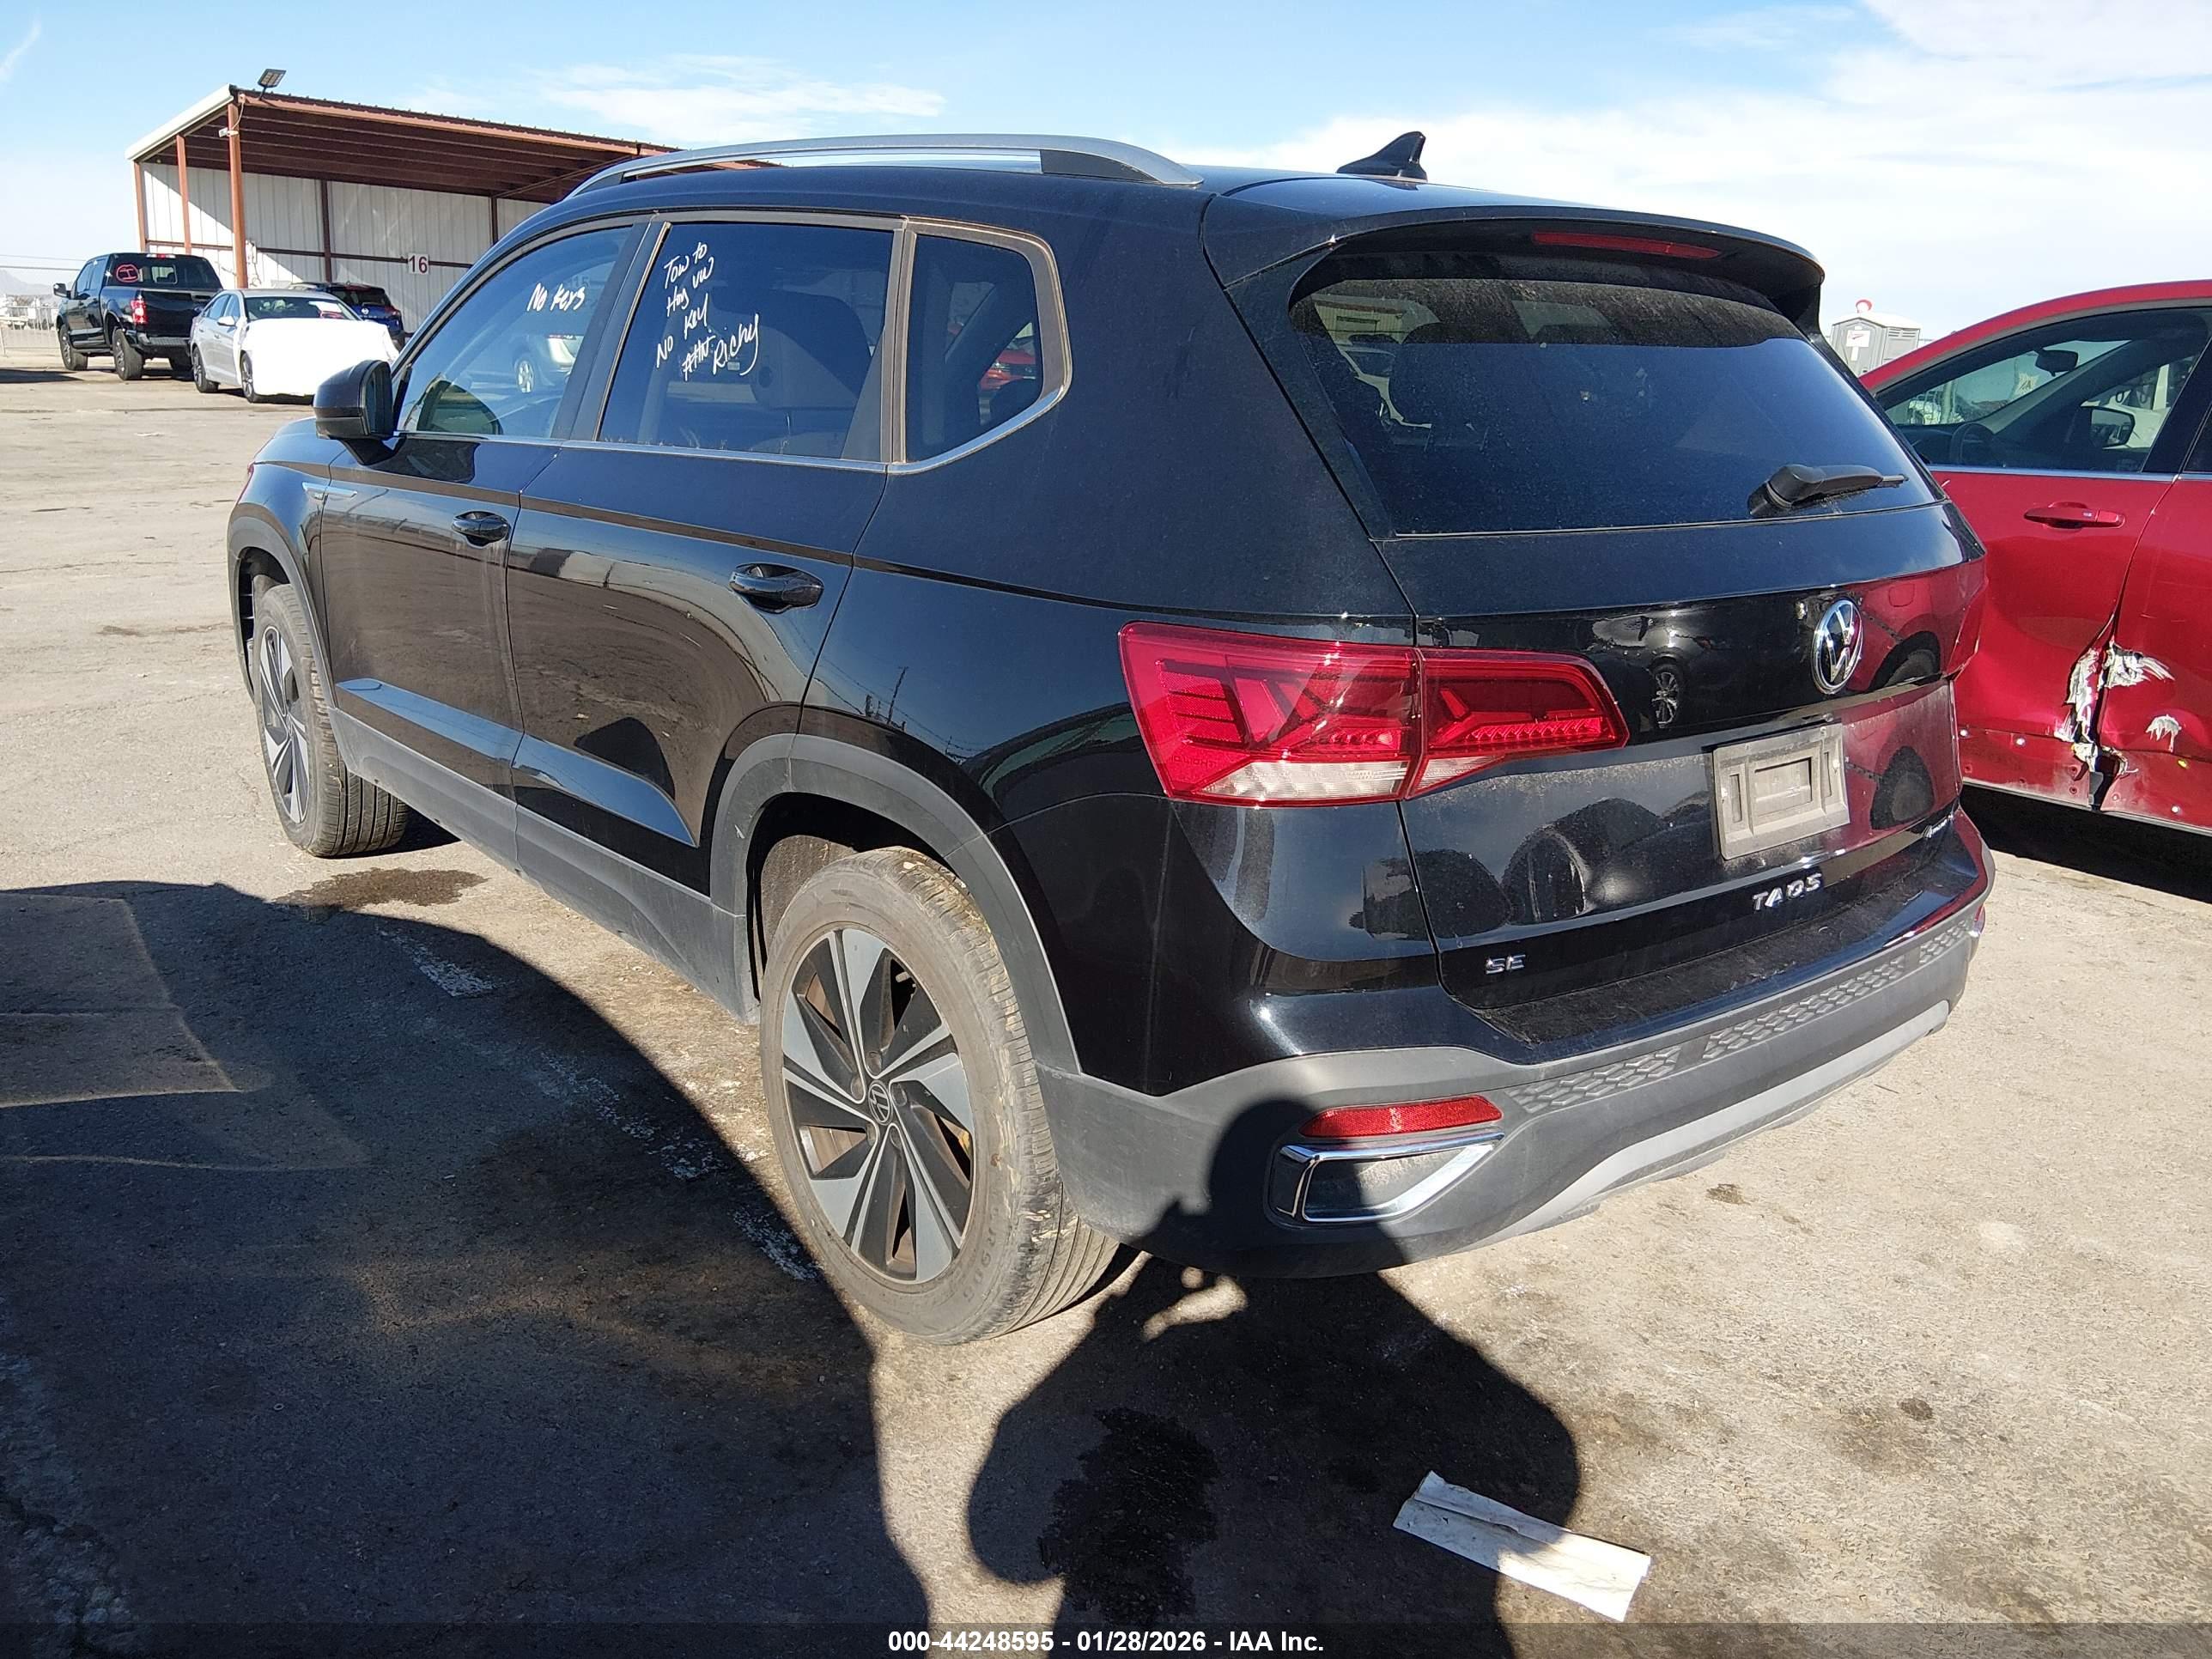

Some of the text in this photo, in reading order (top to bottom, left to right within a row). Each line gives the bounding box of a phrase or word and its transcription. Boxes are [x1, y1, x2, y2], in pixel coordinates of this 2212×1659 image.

[409, 255, 428, 274] 16
[664, 241, 708, 289] Tow to
[1753, 872, 1822, 911] TAOS
[1485, 954, 1526, 975] SE
